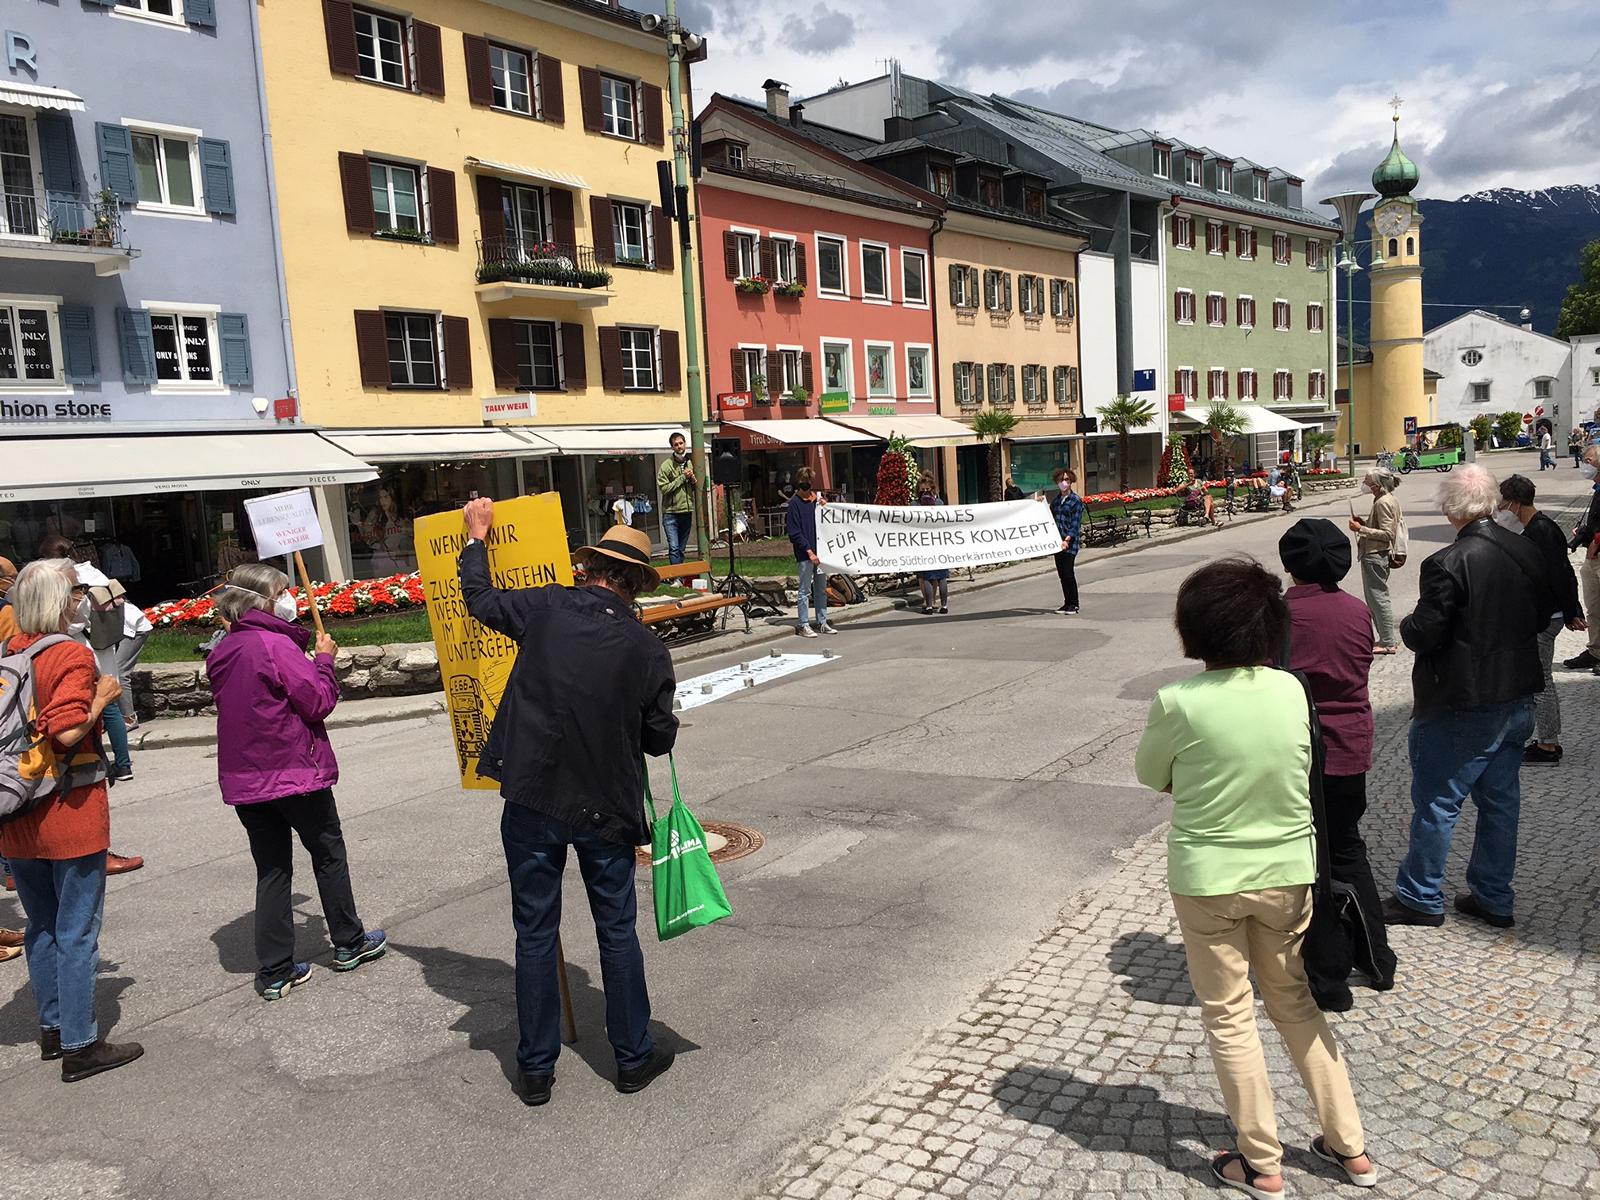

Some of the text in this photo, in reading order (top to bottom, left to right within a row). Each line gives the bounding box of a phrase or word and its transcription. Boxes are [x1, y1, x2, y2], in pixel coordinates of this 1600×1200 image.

[5, 30, 38, 69] R
[156, 351, 172, 360] ONLY
[55, 400, 111, 416] store
[485, 404, 505, 412] TALLY
[750, 434, 766, 445] Tirol
[821, 508, 975, 525] KLIMA NEUTRALES
[488, 523, 518, 546] WIR
[827, 530, 857, 554] FÜR
[875, 521, 1050, 548] VERKEHRS KONZEPT
[843, 545, 869, 567] EIN
[866, 540, 1059, 568] Cadore Südtirol Oberkärnten Osttirol
[442, 623, 455, 642] IM
